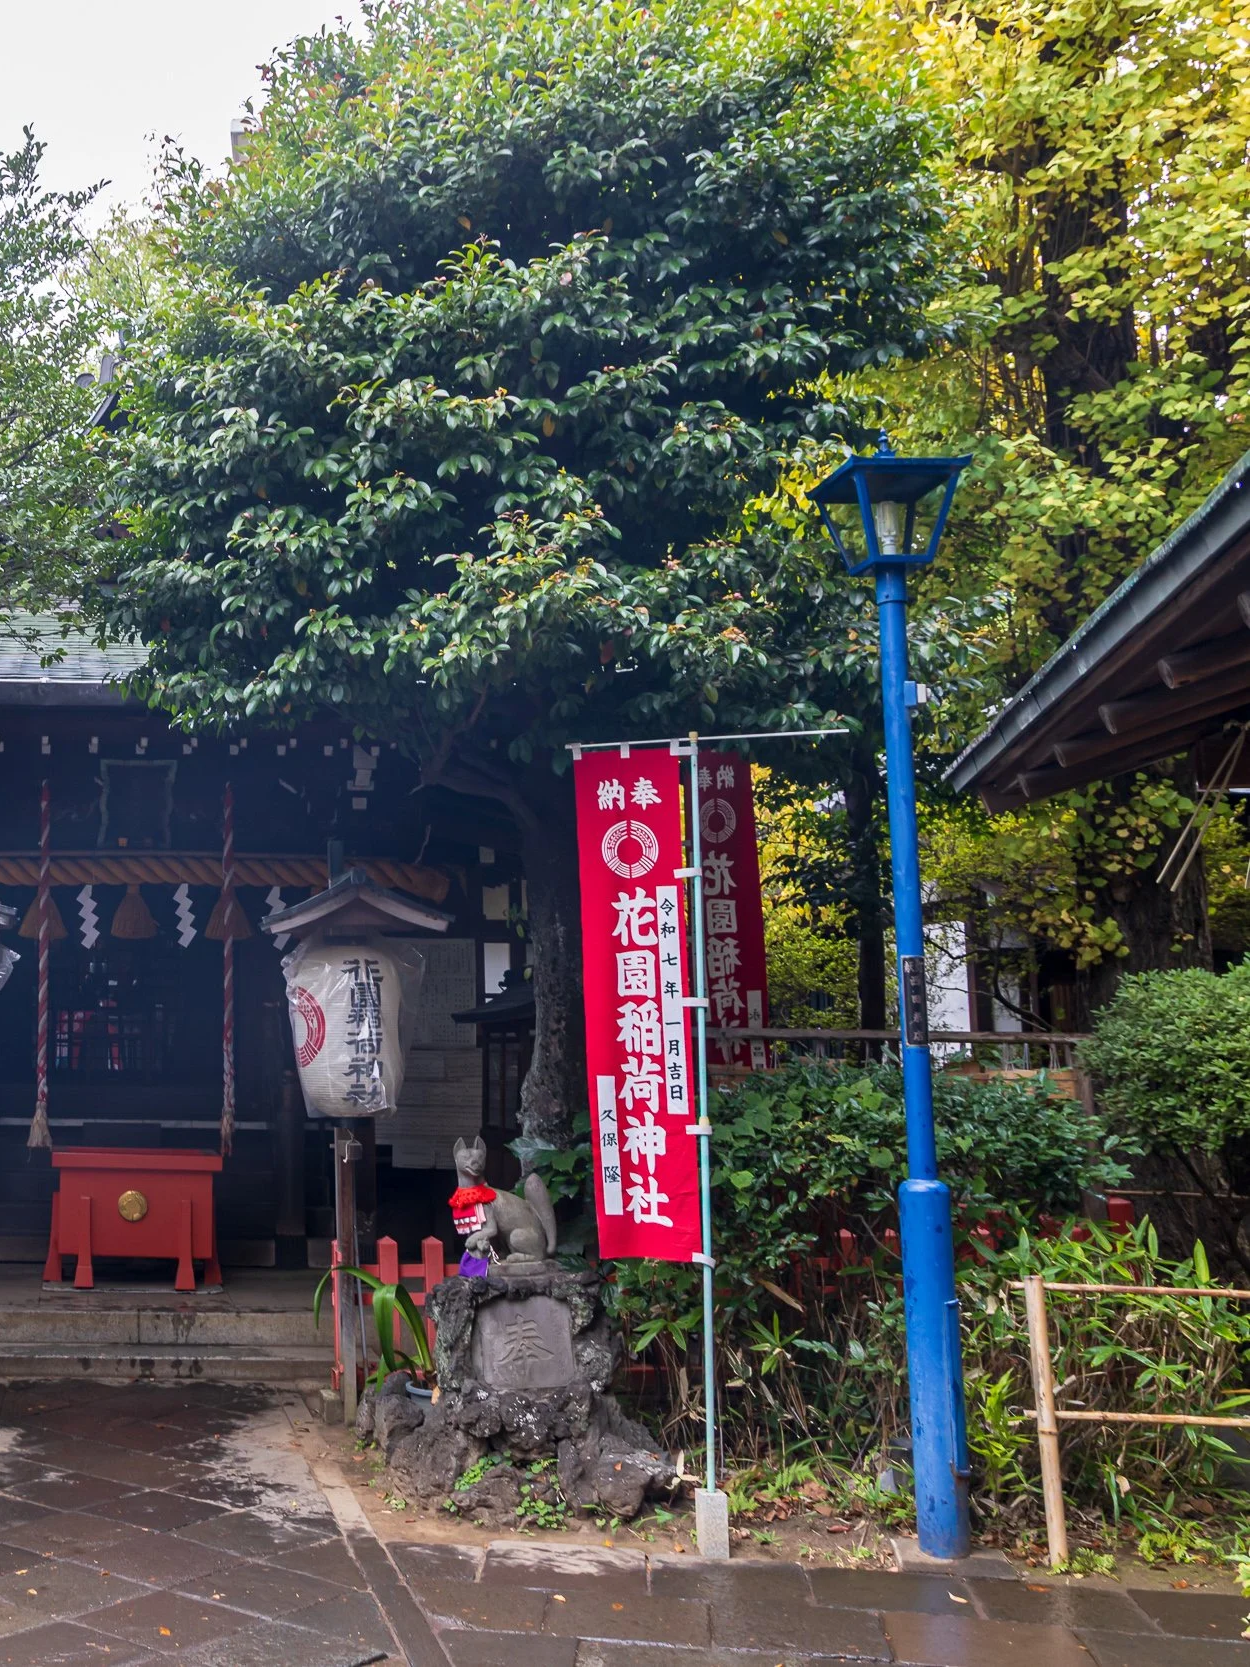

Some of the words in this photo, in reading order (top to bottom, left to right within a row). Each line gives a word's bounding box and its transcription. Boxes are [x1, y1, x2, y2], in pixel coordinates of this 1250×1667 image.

[612, 886, 674, 1228] 花園稲荷神社
